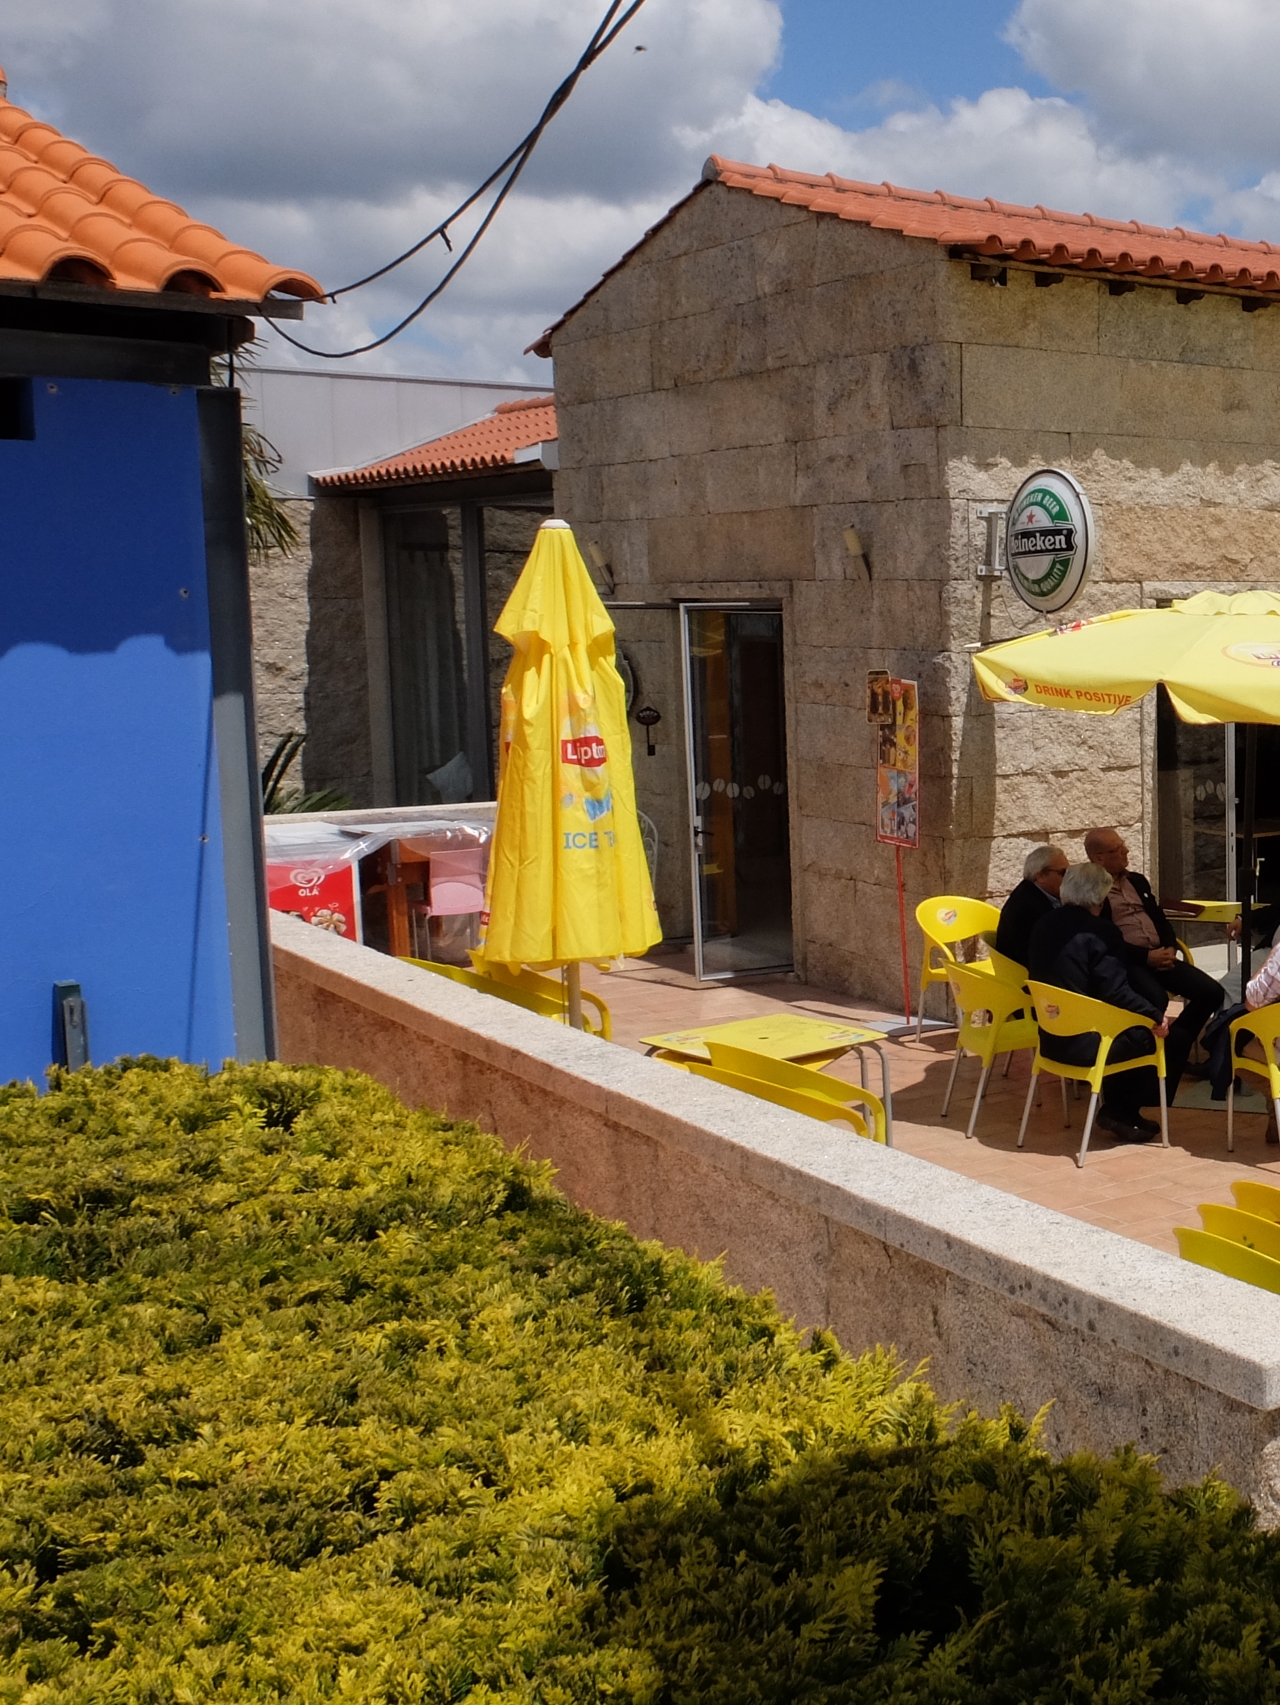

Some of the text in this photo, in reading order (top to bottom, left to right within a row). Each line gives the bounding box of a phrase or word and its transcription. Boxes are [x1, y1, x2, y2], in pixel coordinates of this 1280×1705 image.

[1034, 684, 1073, 699] DRINK
[1075, 690, 1132, 706] POSITIVE
[563, 832, 599, 850] ICE
[298, 886, 319, 897] OLÁ
